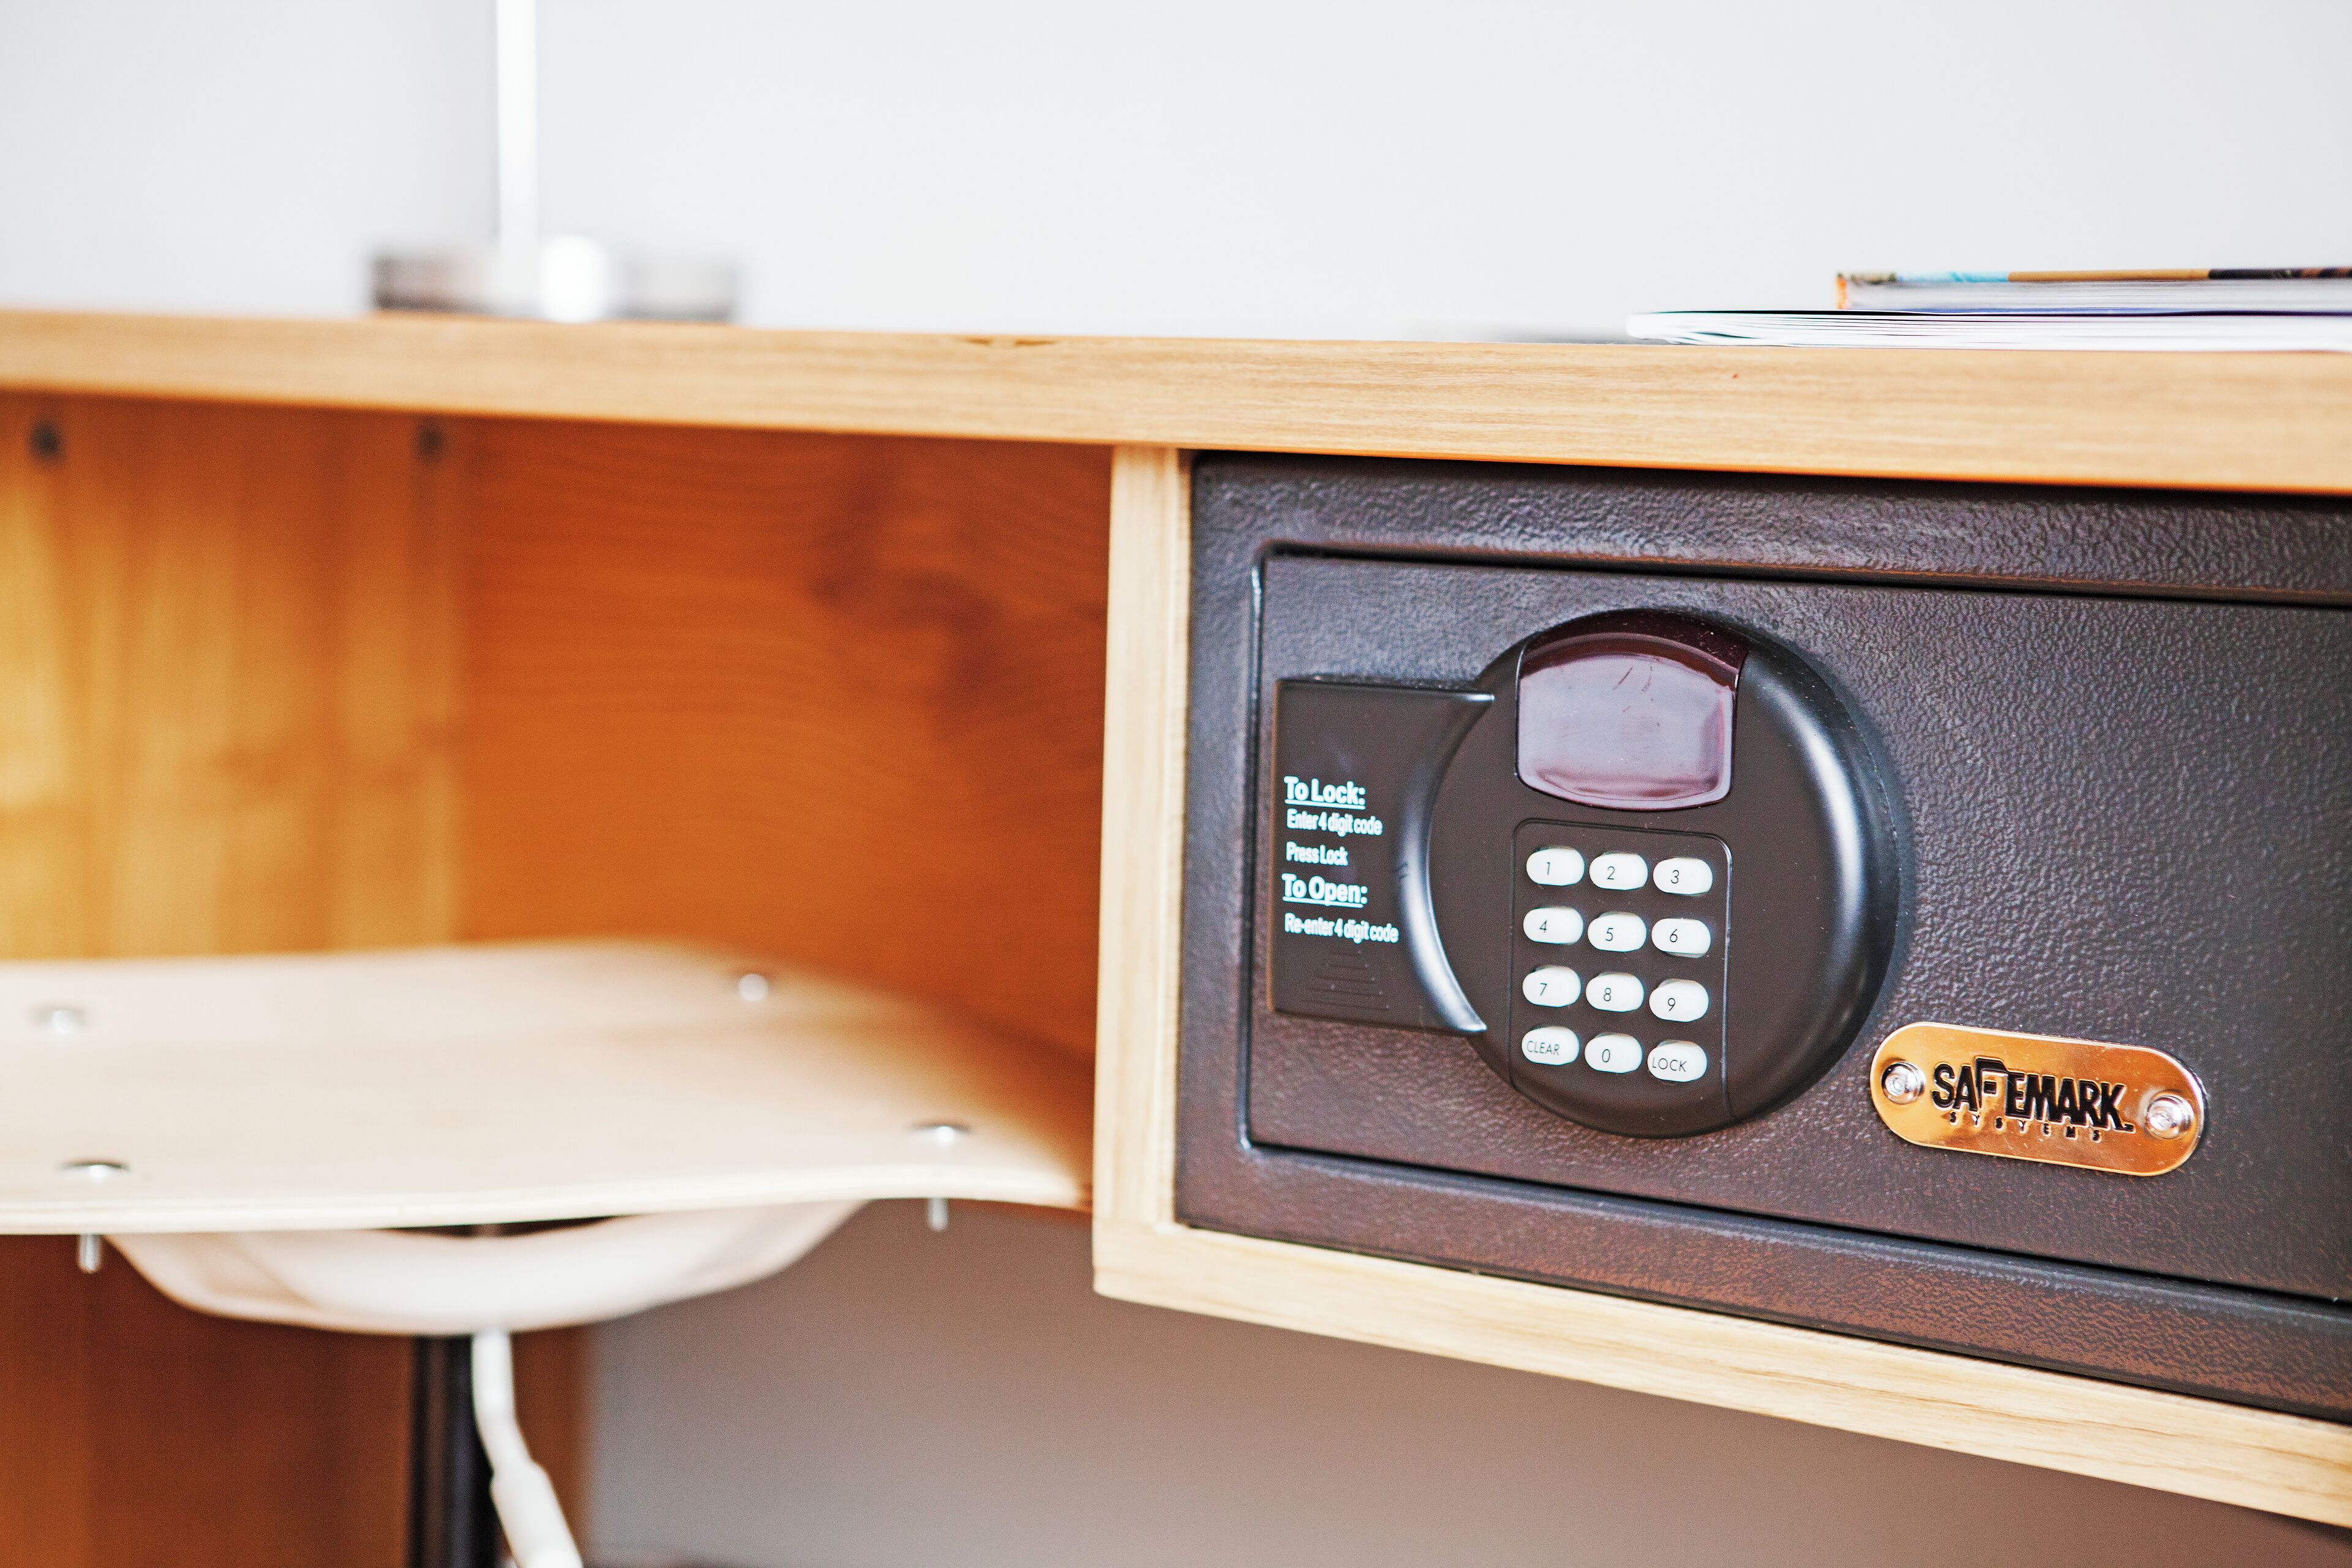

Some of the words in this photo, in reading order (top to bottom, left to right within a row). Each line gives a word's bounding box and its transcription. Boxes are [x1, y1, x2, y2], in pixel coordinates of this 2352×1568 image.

[1284, 775, 1309, 801] To
[1311, 778, 1366, 805] Lock:
[1287, 808, 1319, 830] Enter
[1318, 811, 1327, 831] 4
[1327, 812, 1354, 837] digit
[1354, 815, 1383, 836] code
[1286, 841, 1319, 862] Press
[1319, 845, 1349, 866] Lock
[1546, 861, 1551, 875] 1
[1607, 866, 1615, 880] 2
[1670, 870, 1679, 884] 3
[1281, 873, 1306, 898] To
[1308, 876, 1368, 907] Open:
[1284, 913, 1334, 937] Re-enter
[1334, 918, 1343, 938] 4
[1344, 919, 1370, 944] digit
[1370, 923, 1399, 943] code
[1539, 919, 1547, 933] 4
[1605, 927, 1613, 941] 5
[1669, 929, 1678, 943] 6
[1540, 982, 1548, 996] 7
[1603, 987, 1611, 1001] 8
[1667, 998, 1676, 1011] 9
[1526, 1040, 1560, 1055] CLEAR
[1602, 1049, 1610, 1063] 0
[1652, 1057, 1687, 1072] LOCK
